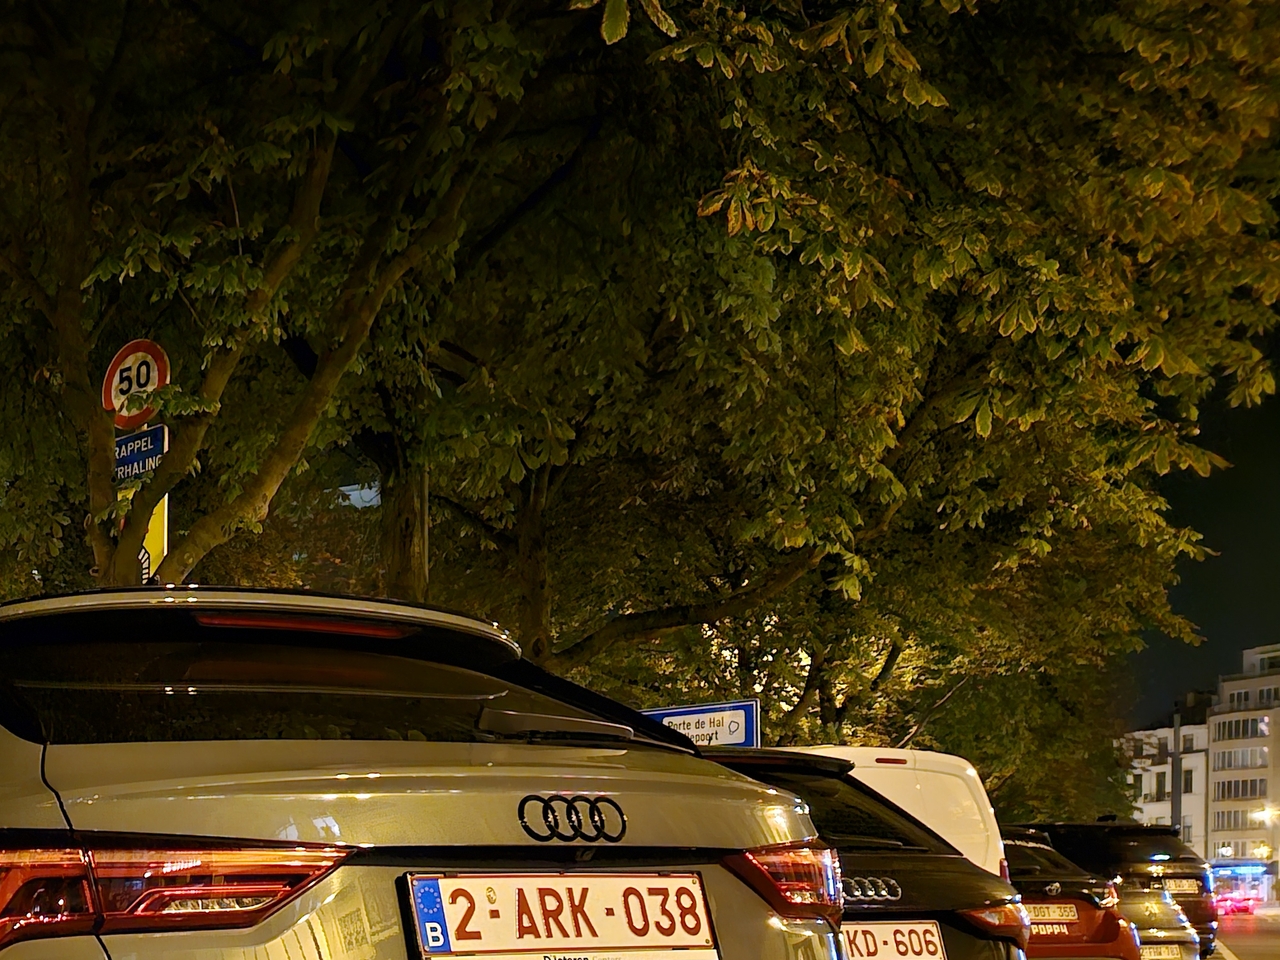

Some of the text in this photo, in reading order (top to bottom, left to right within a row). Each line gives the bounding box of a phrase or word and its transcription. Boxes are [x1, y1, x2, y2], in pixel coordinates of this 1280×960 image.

[118, 360, 151, 396] 50
[115, 436, 153, 460] RAPPEL
[114, 454, 162, 480] RHALING
[694, 719, 706, 729] de
[709, 716, 724, 728] Hal
[424, 922, 445, 947] B
[1031, 924, 1069, 935] POPPY
